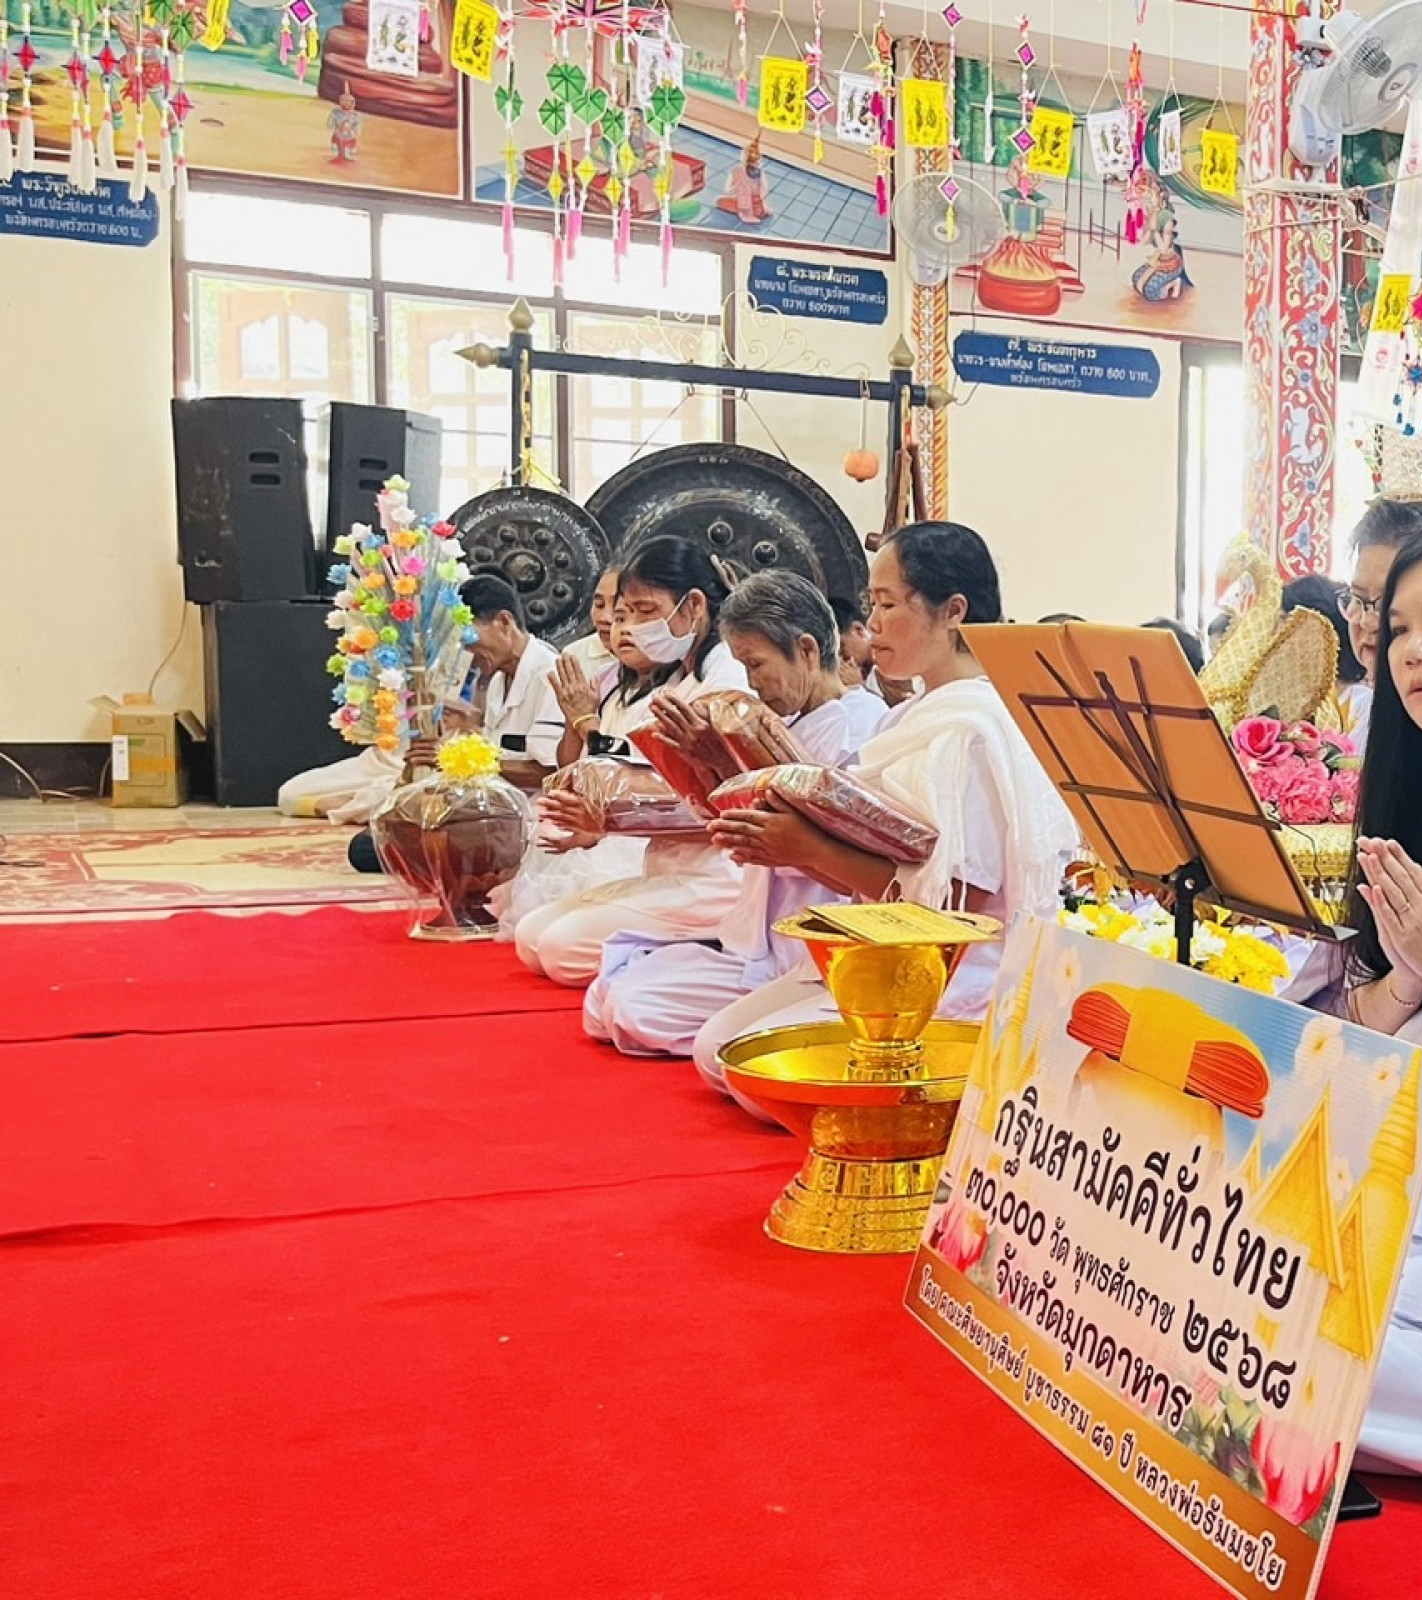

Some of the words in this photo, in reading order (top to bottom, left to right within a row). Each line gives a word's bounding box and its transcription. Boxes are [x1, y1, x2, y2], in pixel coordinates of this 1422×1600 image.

[994, 1086, 1301, 1310] กฐินสามัคคีทั่วไทย
[997, 1243, 1193, 1427] จังหวัดมุกดาหาร
[1050, 1216, 1070, 1264] วัด
[1073, 1246, 1175, 1334] พุทธศักราช
[1183, 1299, 1297, 1409] ๒๕๖๘
[921, 1266, 939, 1307] โดย
[940, 1293, 1026, 1378] คณะศิษยานุศิษย์
[1026, 1367, 1088, 1434] บูชาธรรม
[1092, 1423, 1114, 1458] ๘๑
[1119, 1435, 1131, 1468] ปี
[1136, 1455, 1283, 1588] หลวงพ่อธัมมชโย
